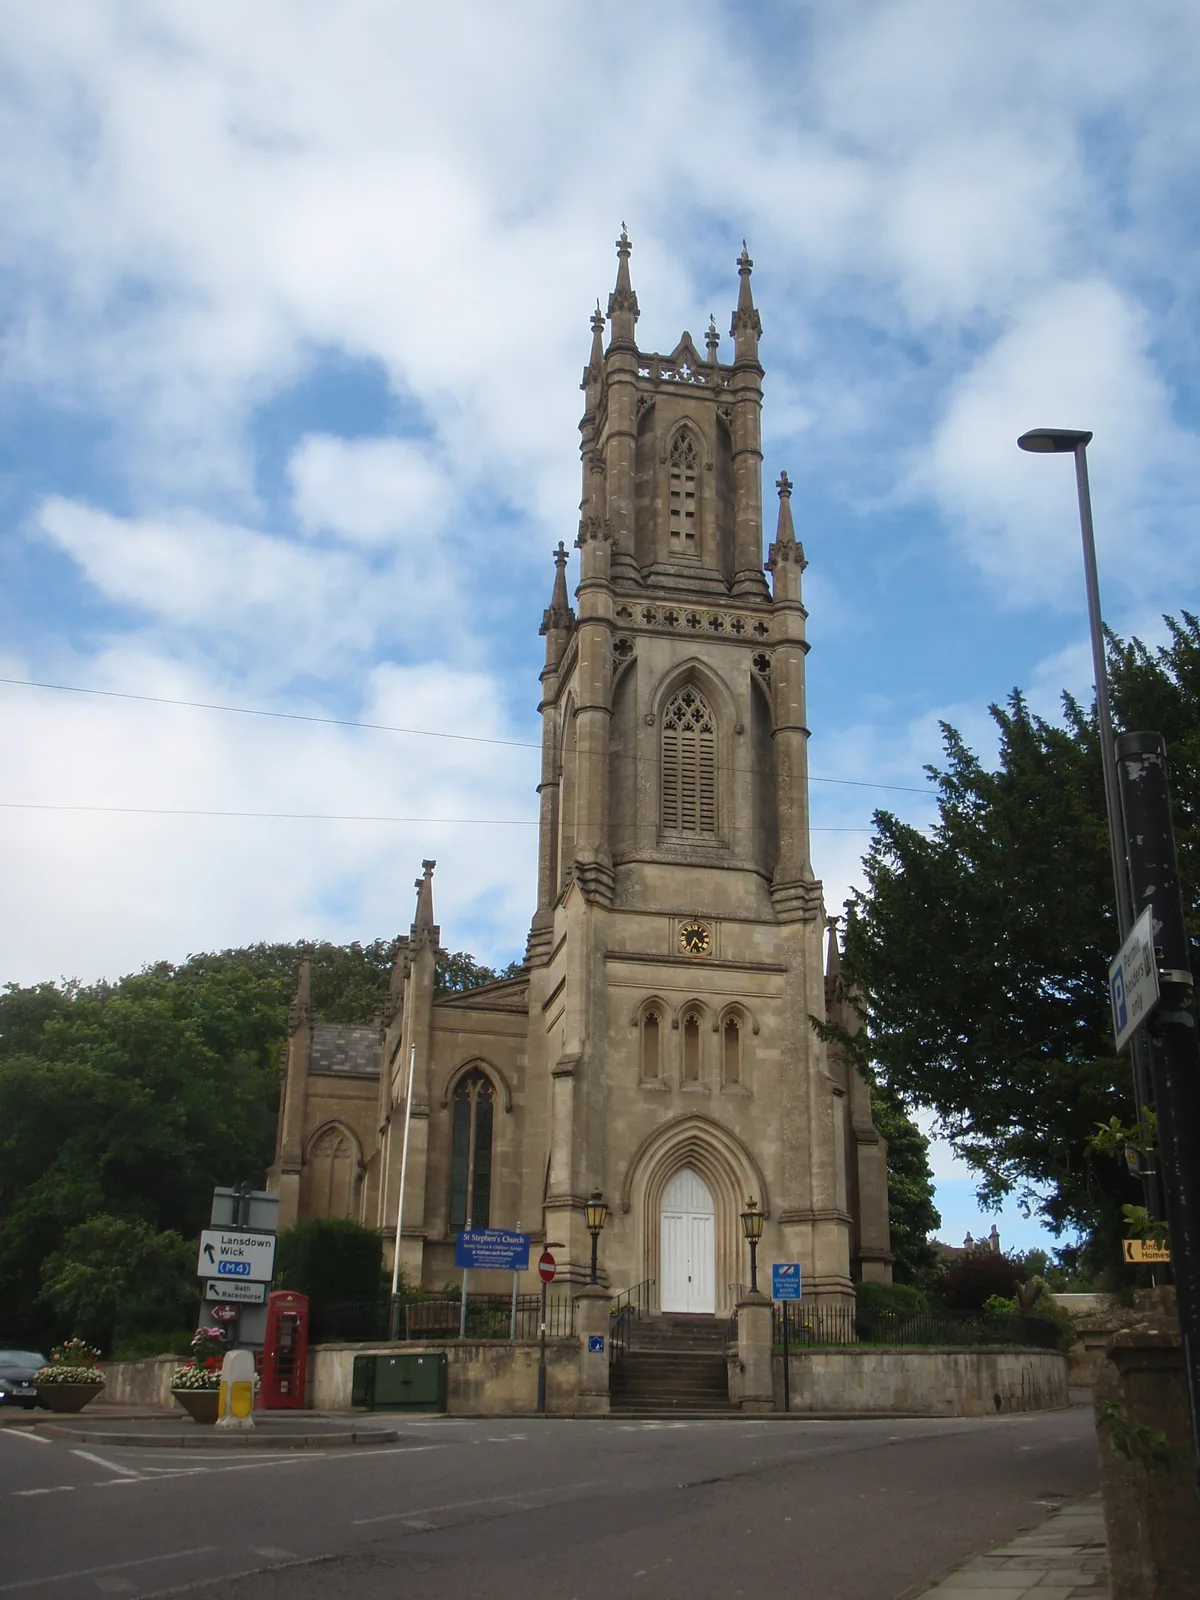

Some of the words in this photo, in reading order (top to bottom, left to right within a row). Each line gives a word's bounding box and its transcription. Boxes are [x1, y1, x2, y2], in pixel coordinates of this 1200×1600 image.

[1123, 935, 1141, 972] Permit
[1124, 961, 1144, 997] holders
[1114, 972, 1124, 1028] P
[1131, 991, 1143, 1017] only
[221, 1235, 271, 1248] Lansdown
[463, 1233, 470, 1241] St
[471, 1233, 501, 1243] Stephen's
[502, 1235, 525, 1244] Church
[220, 1246, 245, 1257] Wick
[1141, 1251, 1169, 1259] Homes
[220, 1261, 249, 1275] (M4)
[234, 1284, 251, 1292] Bath
[222, 1291, 262, 1300] Racecourse
